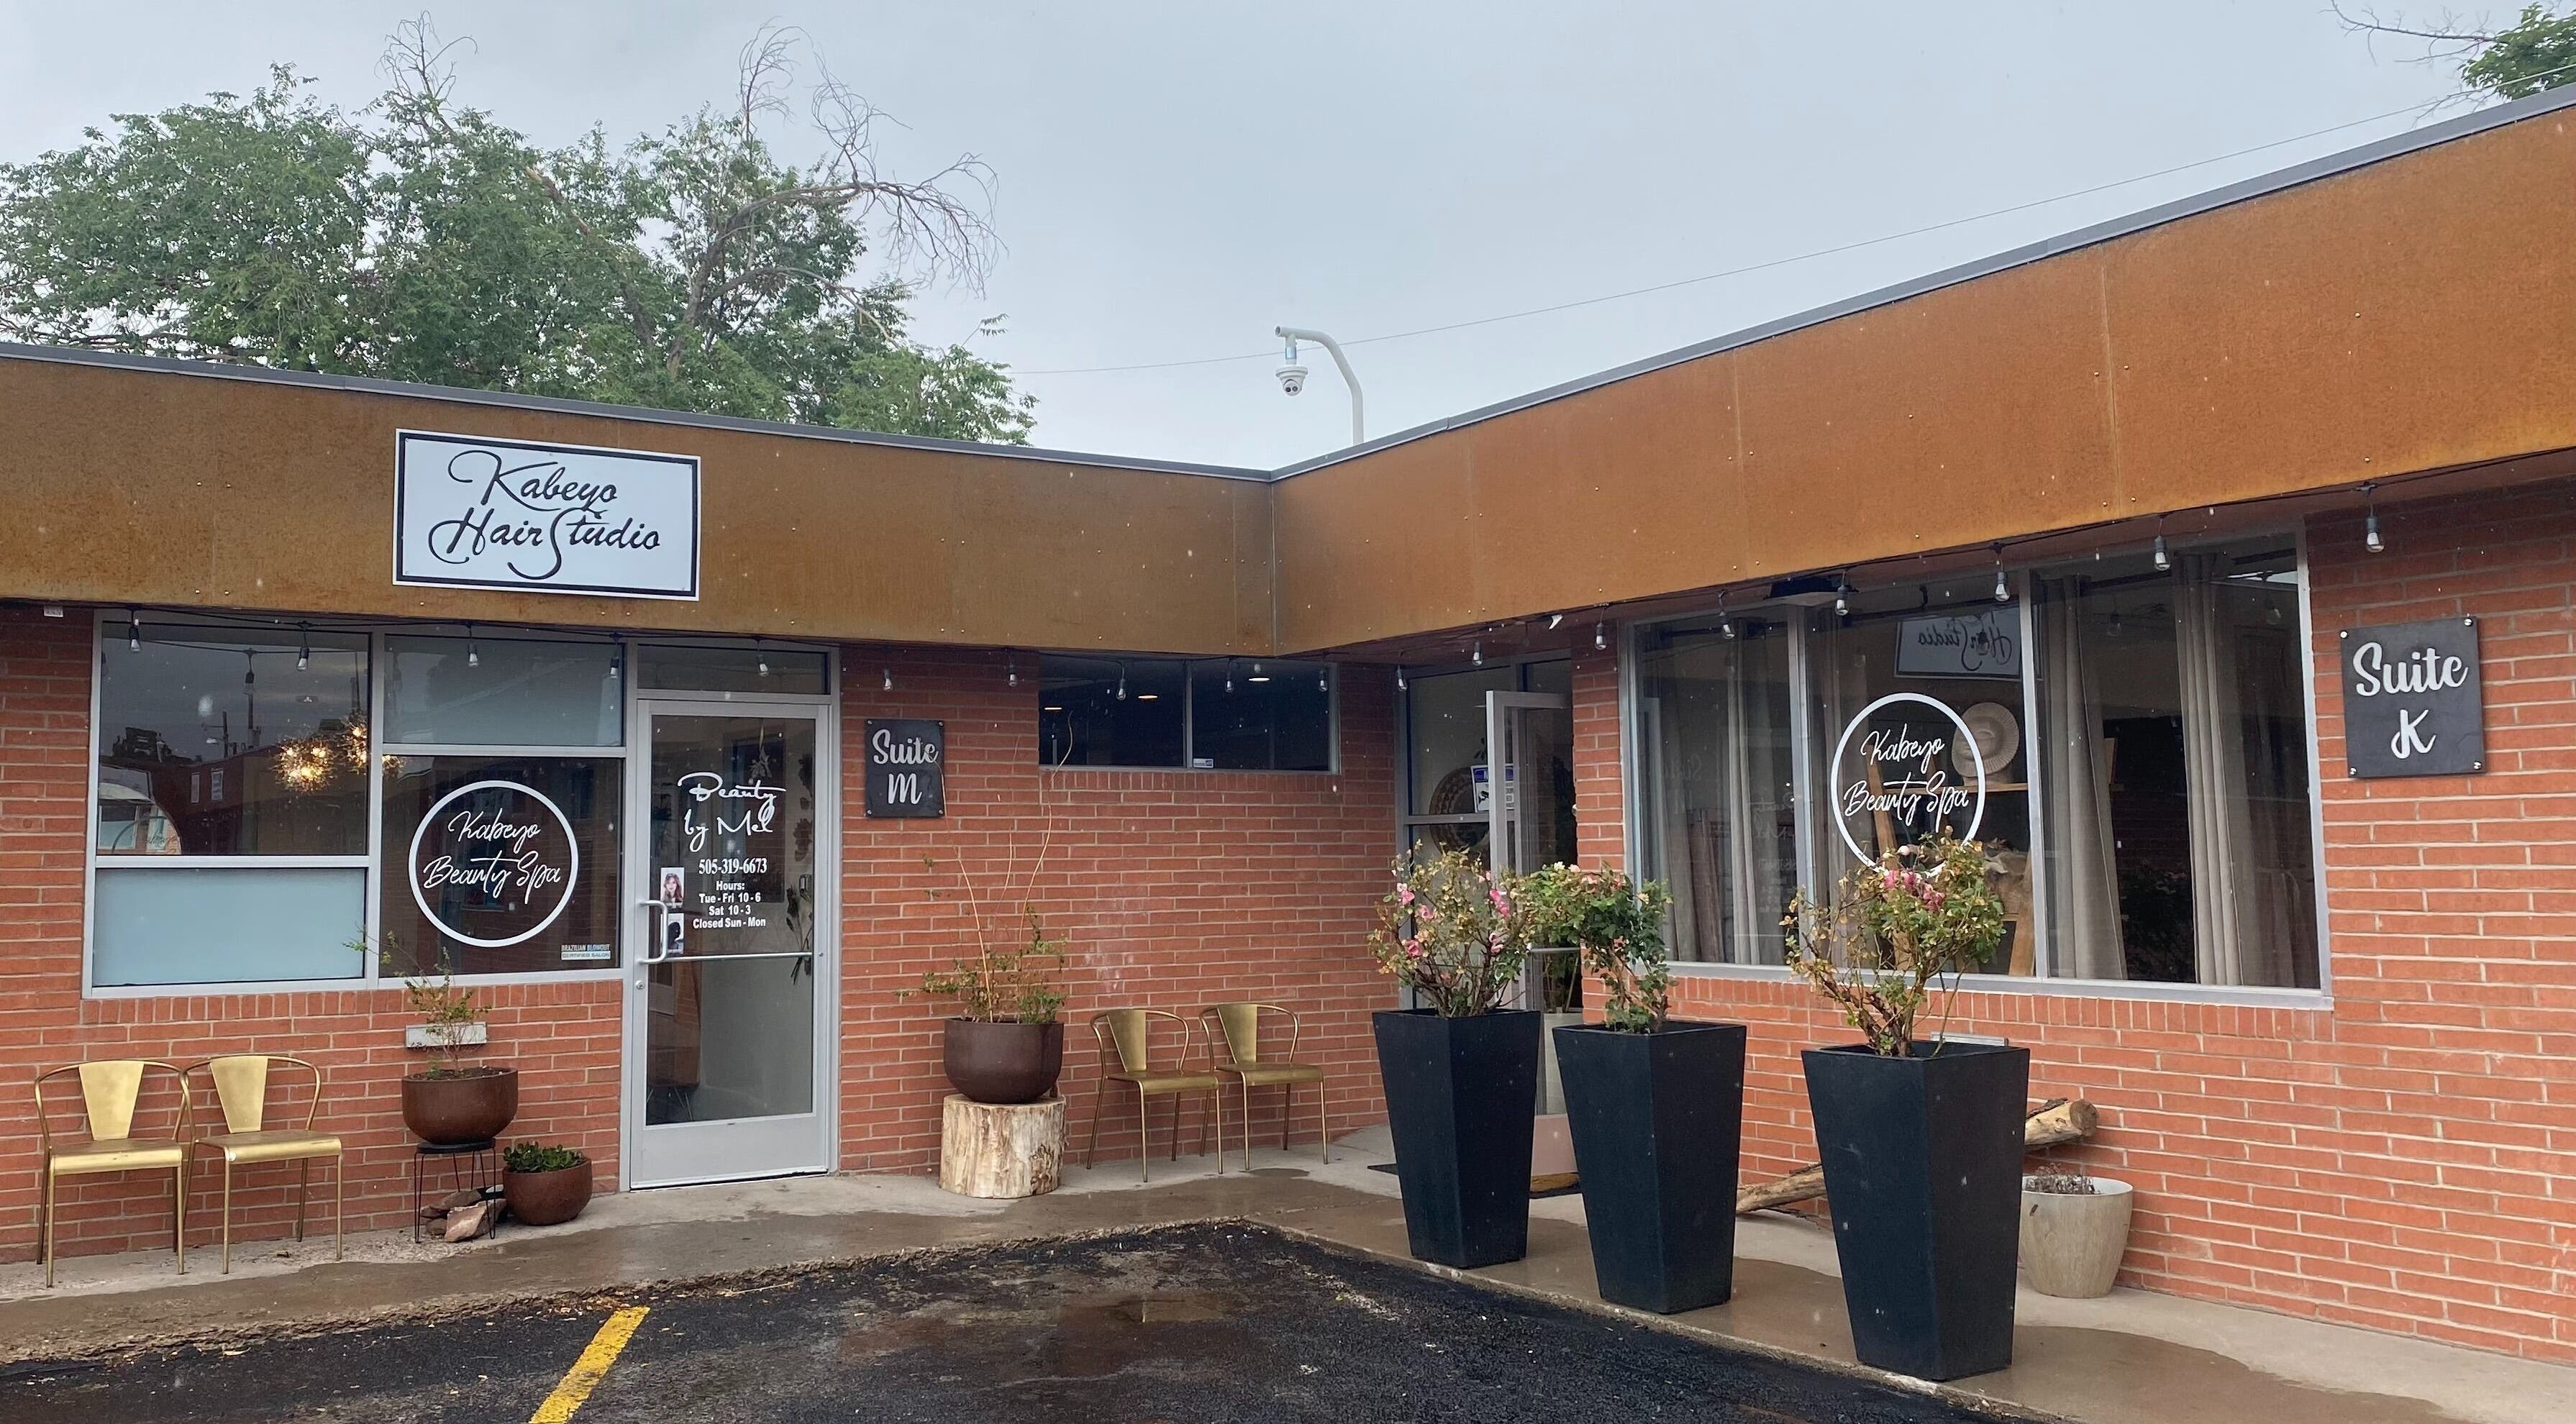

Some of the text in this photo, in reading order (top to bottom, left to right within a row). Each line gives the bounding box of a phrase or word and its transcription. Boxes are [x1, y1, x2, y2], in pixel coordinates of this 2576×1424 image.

[447, 449, 617, 518] Kabeyo
[428, 506, 661, 580] Hair Studio
[2352, 642, 2469, 697] Suite
[872, 729, 939, 765] Suite
[1860, 723, 1945, 775] Kabeyo
[2390, 709, 2436, 759] K
[677, 772, 786, 818] Beauty
[887, 772, 923, 805] M
[1843, 772, 1928, 827] Beauty
[1926, 770, 1970, 834] Spa
[447, 808, 541, 854] Kabeyo
[683, 805, 775, 852] by Mel
[423, 850, 561, 905] Beauty Spa
[698, 858, 768, 874] 505-319-6673
[716, 880, 745, 891] Hours:
[698, 893, 716, 903] Tue
[722, 893, 734, 903] Fri
[738, 893, 749, 903] 10
[755, 892, 761, 903] 6
[709, 905, 724, 916] Sat
[728, 905, 739, 916] 10
[745, 904, 751, 915] 3
[693, 918, 724, 928] Closed
[724, 917, 742, 928] Sun
[748, 916, 766, 927] Mon
